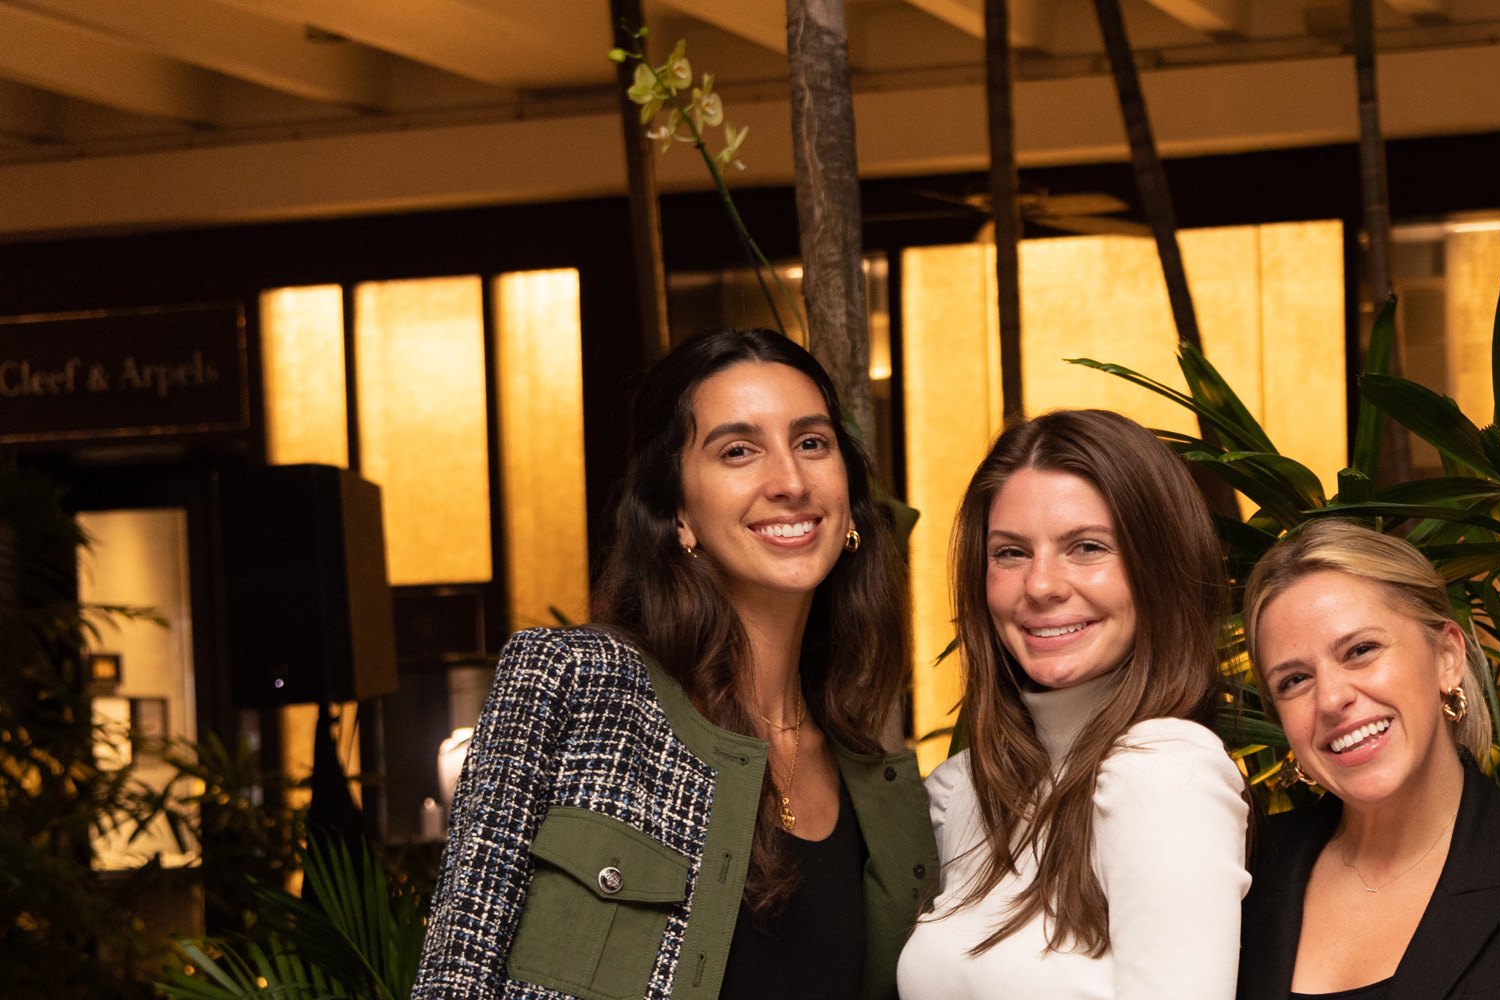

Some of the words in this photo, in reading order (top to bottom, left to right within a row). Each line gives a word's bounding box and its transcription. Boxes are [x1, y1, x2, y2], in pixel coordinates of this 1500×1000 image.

[0, 356, 80, 397] Cleef
[86, 362, 110, 393] &
[121, 351, 219, 398] Arpels
